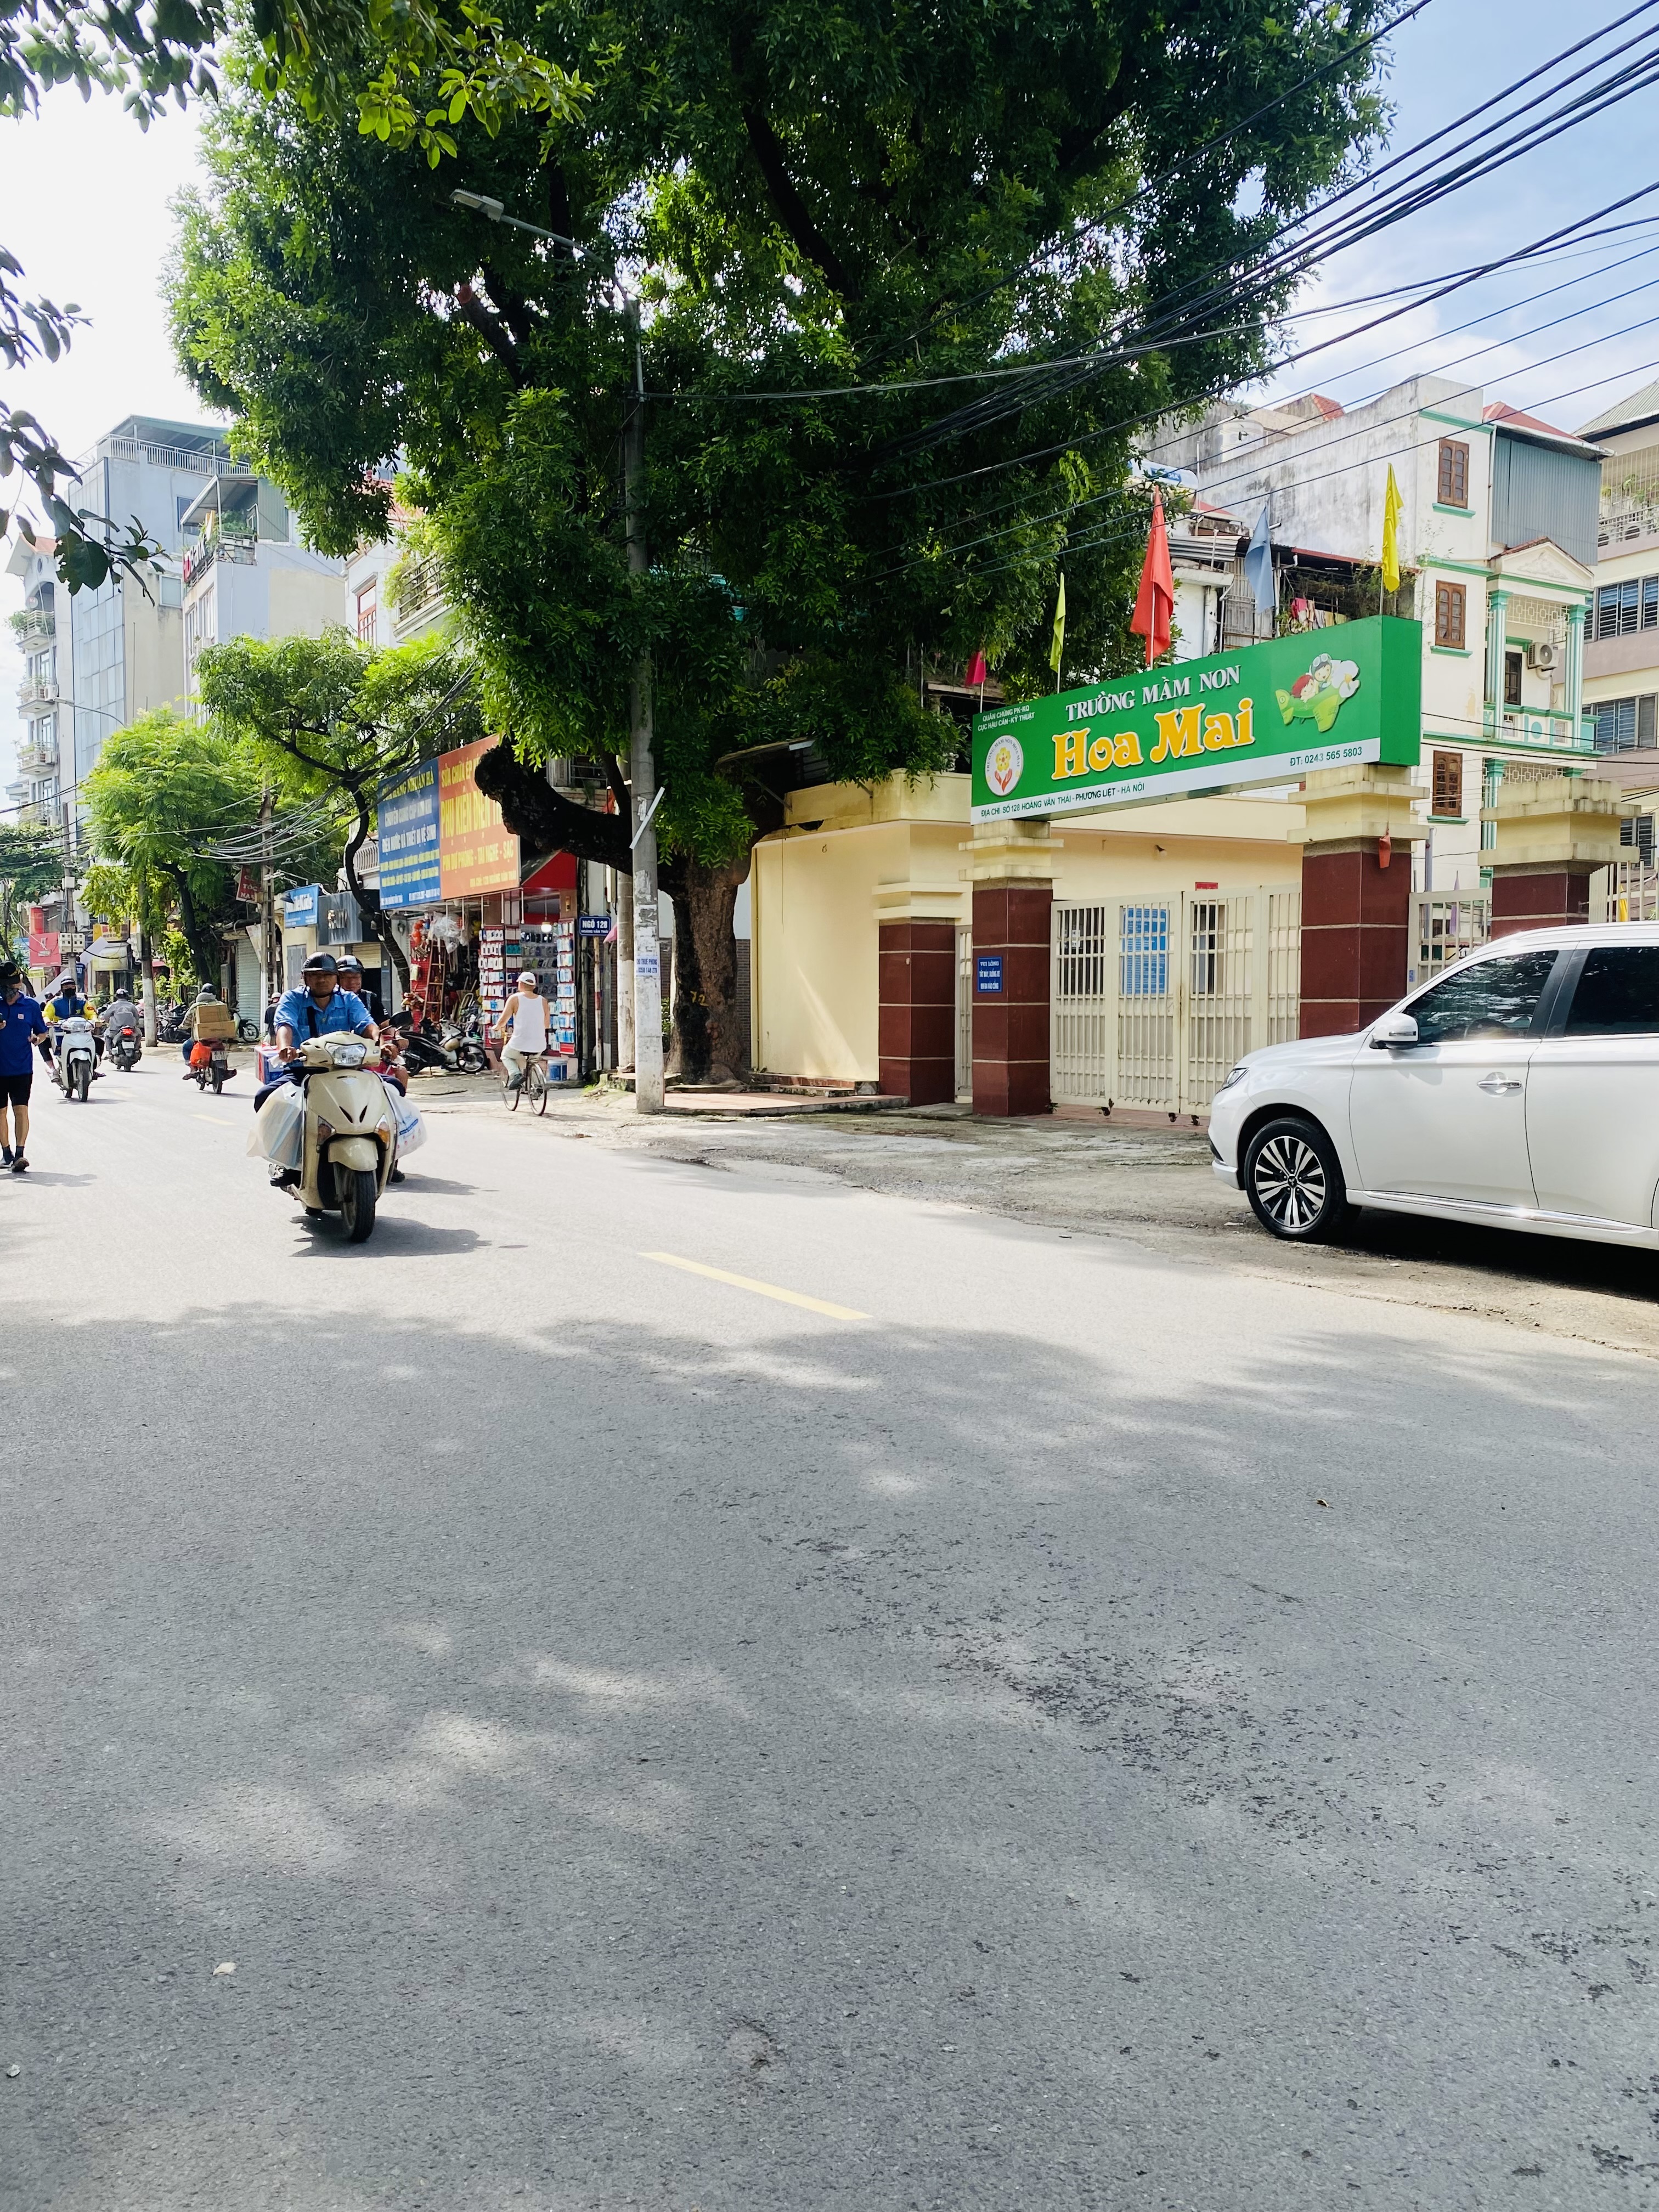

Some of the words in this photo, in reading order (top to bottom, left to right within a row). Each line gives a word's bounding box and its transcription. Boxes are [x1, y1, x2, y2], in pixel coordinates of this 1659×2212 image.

[1066, 690, 1135, 722] TRƯỜNG
[1142, 676, 1191, 705] MẦM
[1199, 665, 1241, 692] NON
[1052, 727, 1144, 780] Hoa
[1150, 697, 1255, 763] Mai
[1305, 753, 1324, 764] 0243
[1326, 751, 1341, 760] 565
[1343, 747, 1362, 758] 5803
[1012, 804, 1020, 812] 128
[1022, 800, 1042, 810] HOÀNG
[1043, 797, 1056, 807] VĂN
[1058, 794, 1071, 805] THÁI
[1075, 790, 1101, 801] PHƯƠNG
[1103, 788, 1116, 798] LIỆT
[1121, 783, 1131, 794] HÀ
[1133, 782, 1144, 793] NỘI
[582, 919, 595, 928] NGÕ
